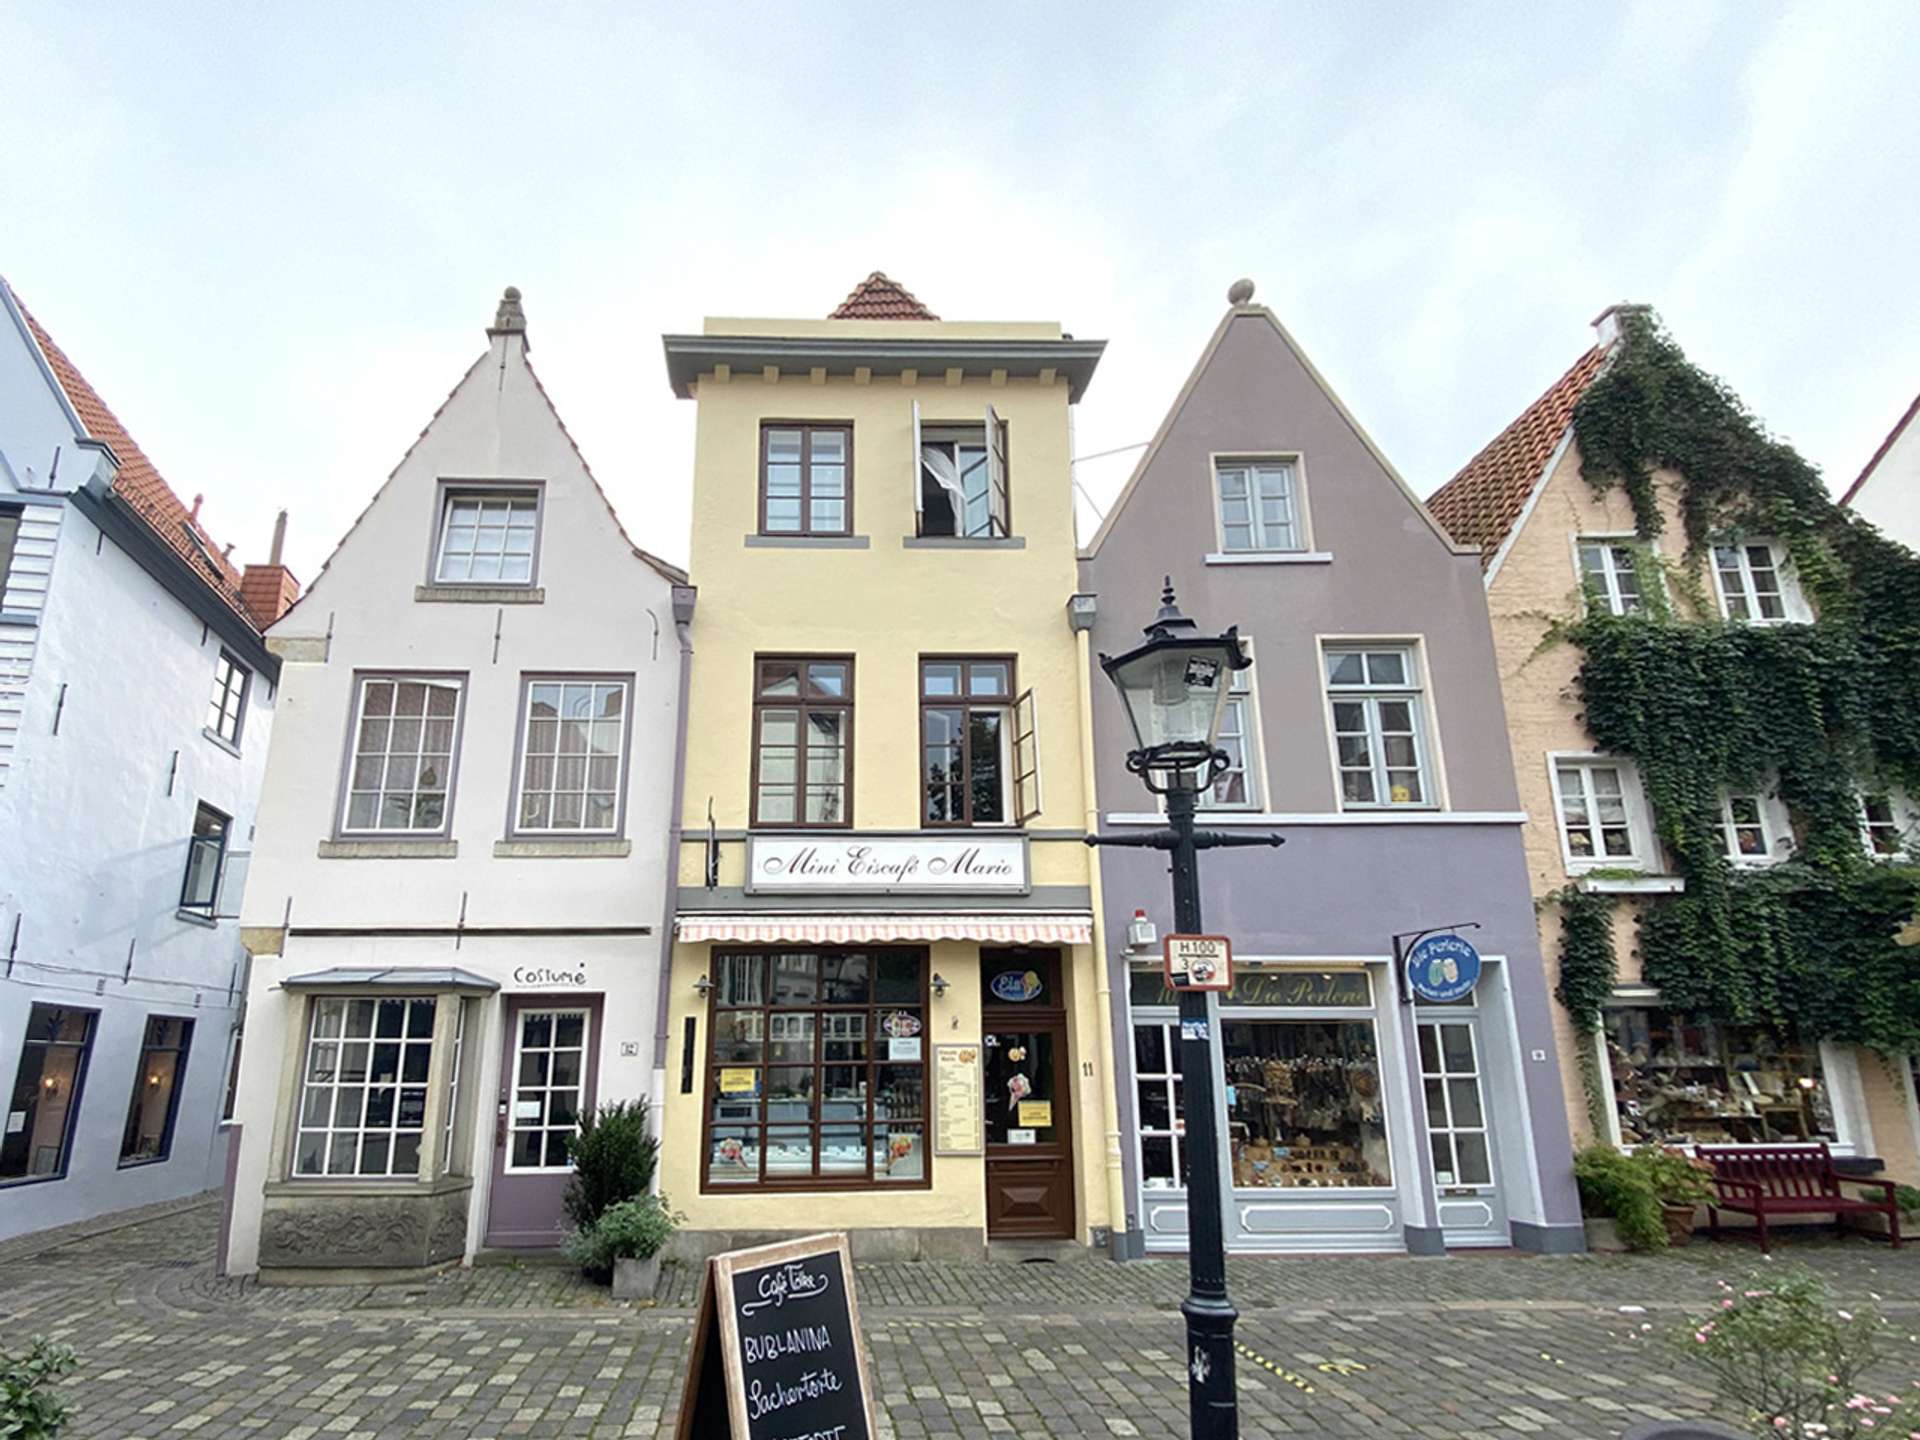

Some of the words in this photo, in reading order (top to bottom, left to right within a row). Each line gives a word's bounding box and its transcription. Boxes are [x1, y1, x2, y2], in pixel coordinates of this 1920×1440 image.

[763, 847, 839, 875] Mini
[927, 848, 1012, 875] Mario
[1082, 1062, 1094, 1076] 11
[744, 1325, 832, 1363] BUBLANINA
